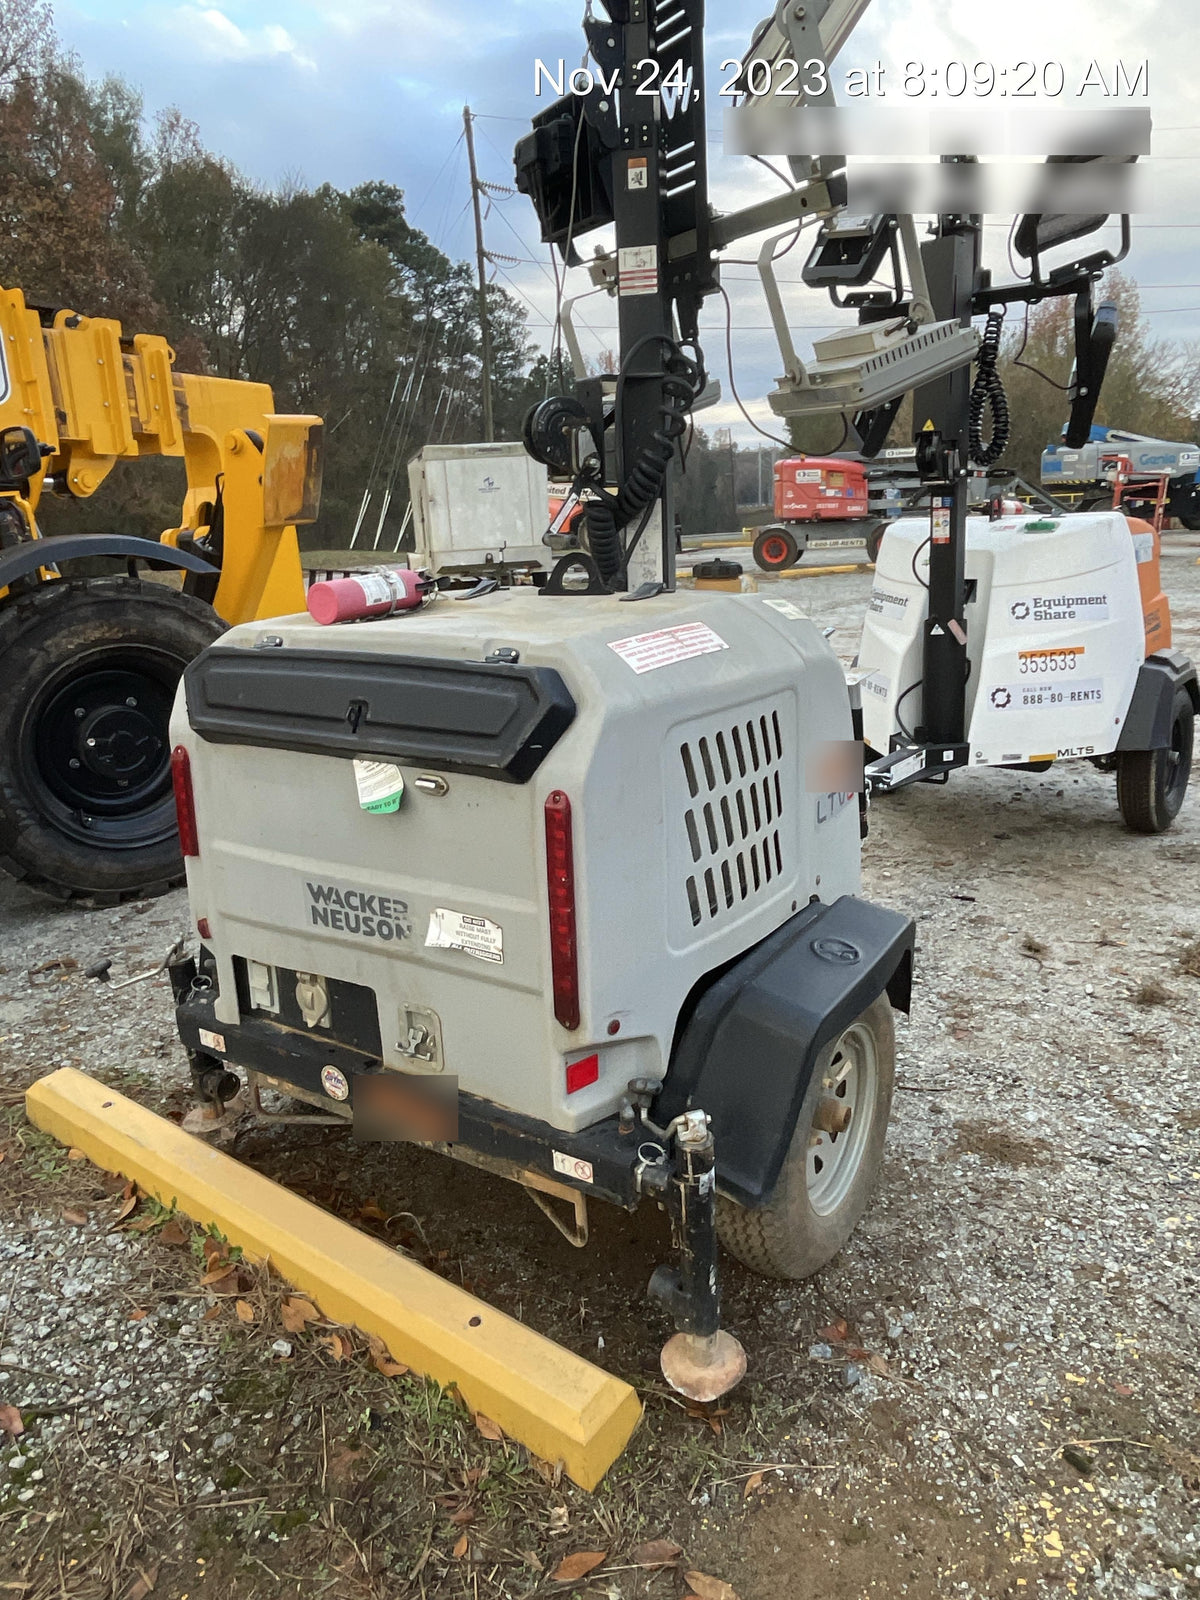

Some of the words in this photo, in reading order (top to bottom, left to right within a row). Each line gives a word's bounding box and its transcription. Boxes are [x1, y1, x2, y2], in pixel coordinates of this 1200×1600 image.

[1139, 453, 1177, 466] Genie
[1033, 594, 1107, 609] Equipment
[1034, 610, 1076, 621] Share
[1018, 651, 1077, 674] 353533
[1022, 690, 1102, 705] 888-80-RENTS
[1057, 746, 1095, 758] MLTS
[311, 905, 412, 941] NEUSON
[459, 923, 475, 932] RAISE
[476, 927, 491, 935] MAST
[456, 930, 479, 940] WITHOUT
[481, 935, 496, 944] FULLY
